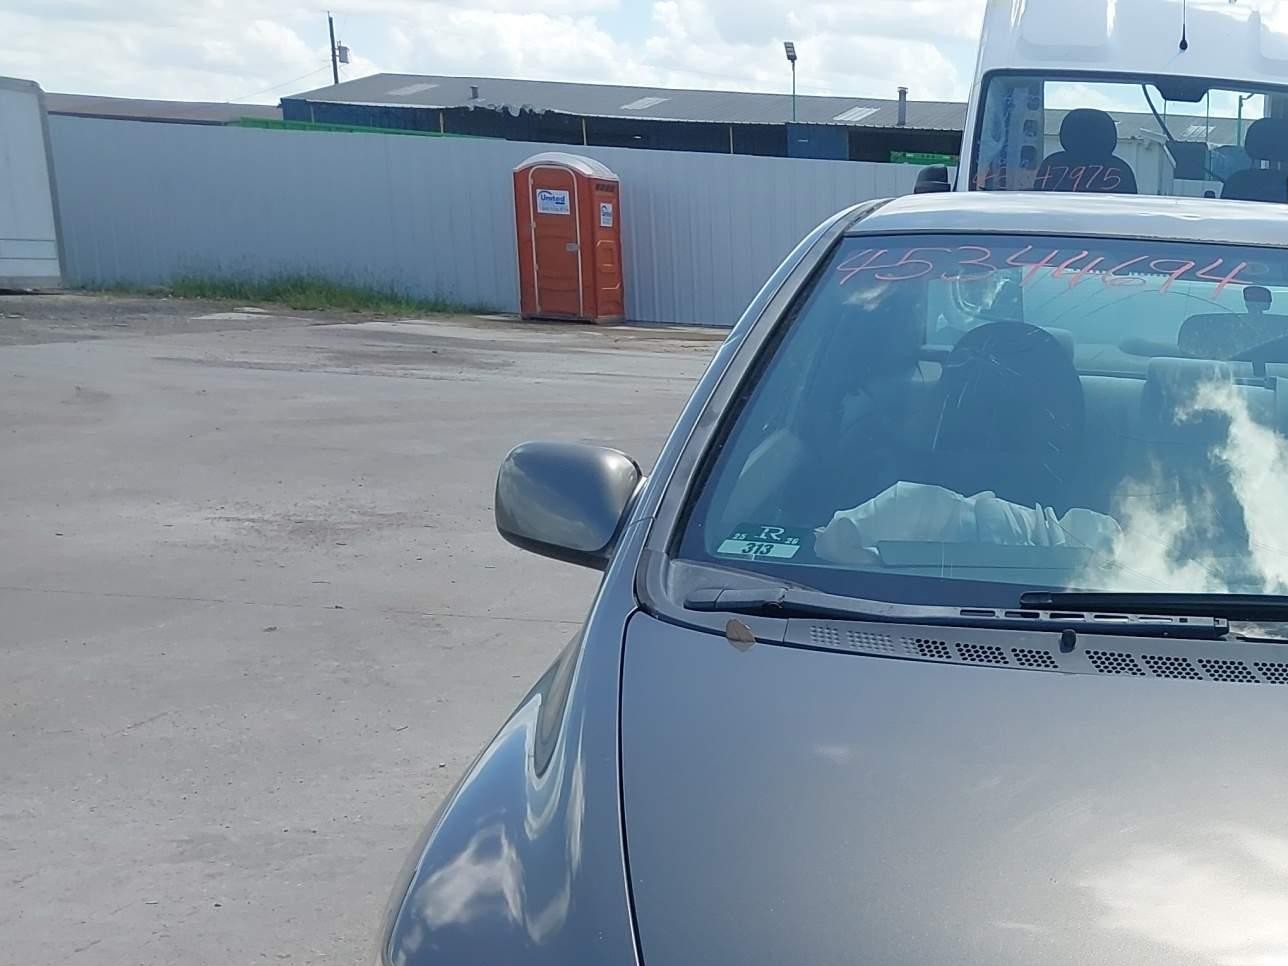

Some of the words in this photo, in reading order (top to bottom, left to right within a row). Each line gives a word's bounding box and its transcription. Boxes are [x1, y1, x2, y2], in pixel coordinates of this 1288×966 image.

[540, 194, 565, 203] United
[836, 245, 1254, 300] 45344694
[742, 542, 774, 555] 313
